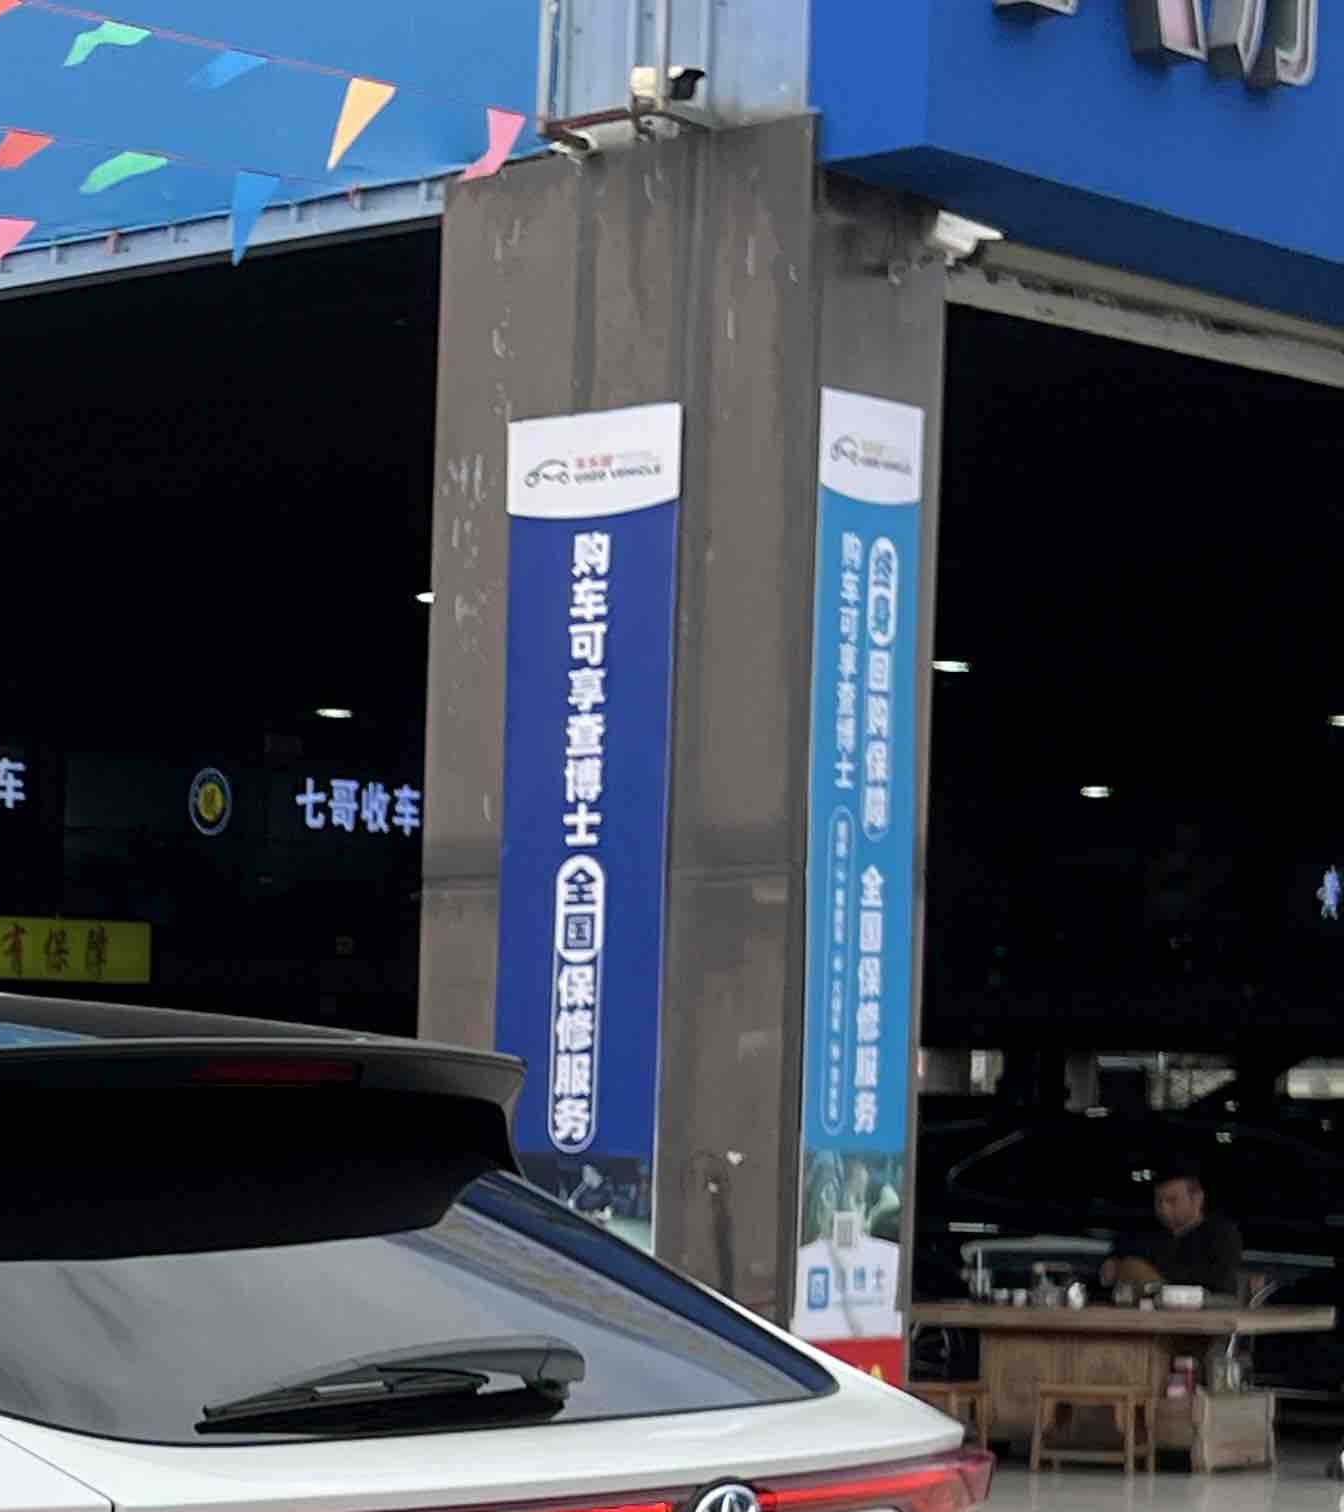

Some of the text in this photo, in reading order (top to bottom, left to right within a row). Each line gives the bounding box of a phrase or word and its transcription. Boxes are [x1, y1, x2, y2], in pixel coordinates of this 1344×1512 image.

[295, 776, 422, 837] 七哥收车
[551, 531, 612, 1144] 购车可享查博士 全国保修服务
